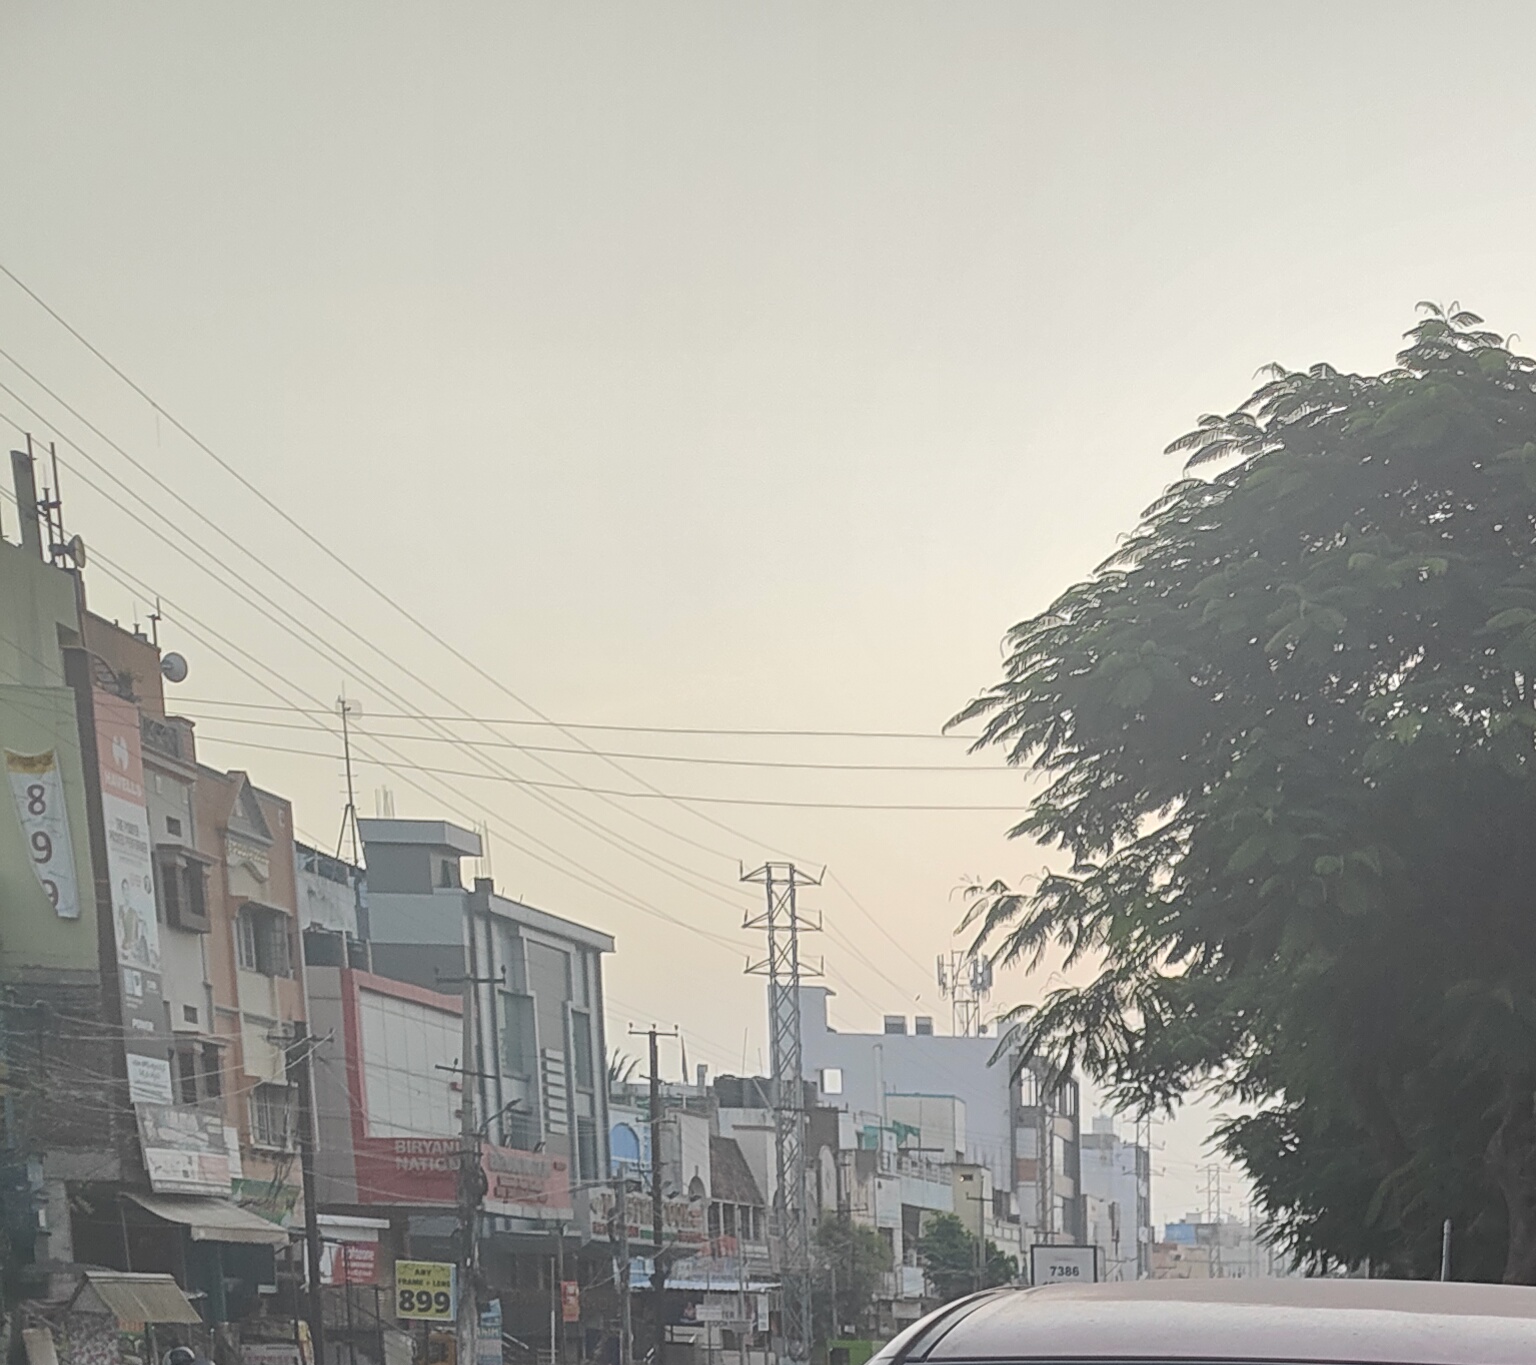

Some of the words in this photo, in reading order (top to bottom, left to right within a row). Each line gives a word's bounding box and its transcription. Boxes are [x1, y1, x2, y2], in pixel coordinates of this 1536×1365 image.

[395, 1140, 460, 1154] BIRYANI
[1050, 1266, 1080, 1277] 7386
[398, 1278, 424, 1286] FRAME
[399, 1289, 451, 1314] 899
